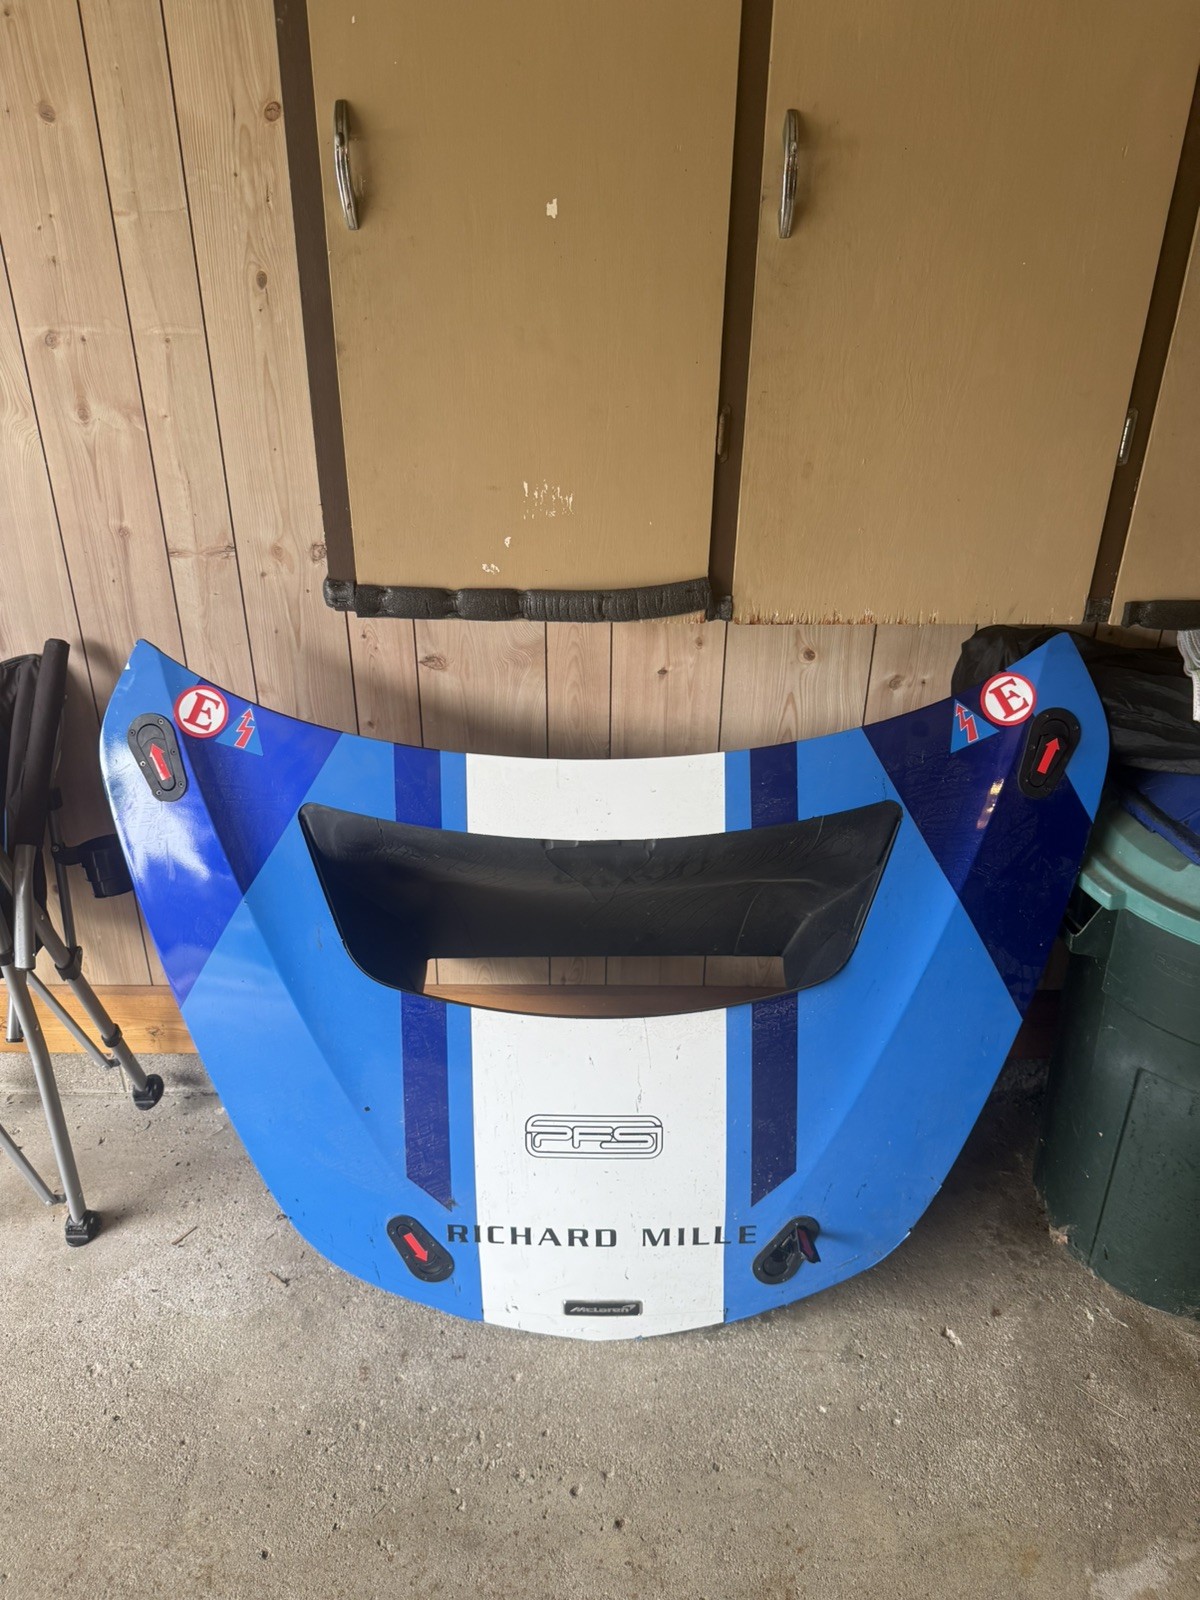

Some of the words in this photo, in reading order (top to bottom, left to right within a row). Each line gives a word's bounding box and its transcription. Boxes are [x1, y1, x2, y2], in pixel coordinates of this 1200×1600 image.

[183, 692, 221, 731] E
[989, 678, 1029, 720] E
[526, 1124, 663, 1150] PFS
[447, 1223, 617, 1248] RICHARD
[642, 1225, 757, 1247] MILLE
